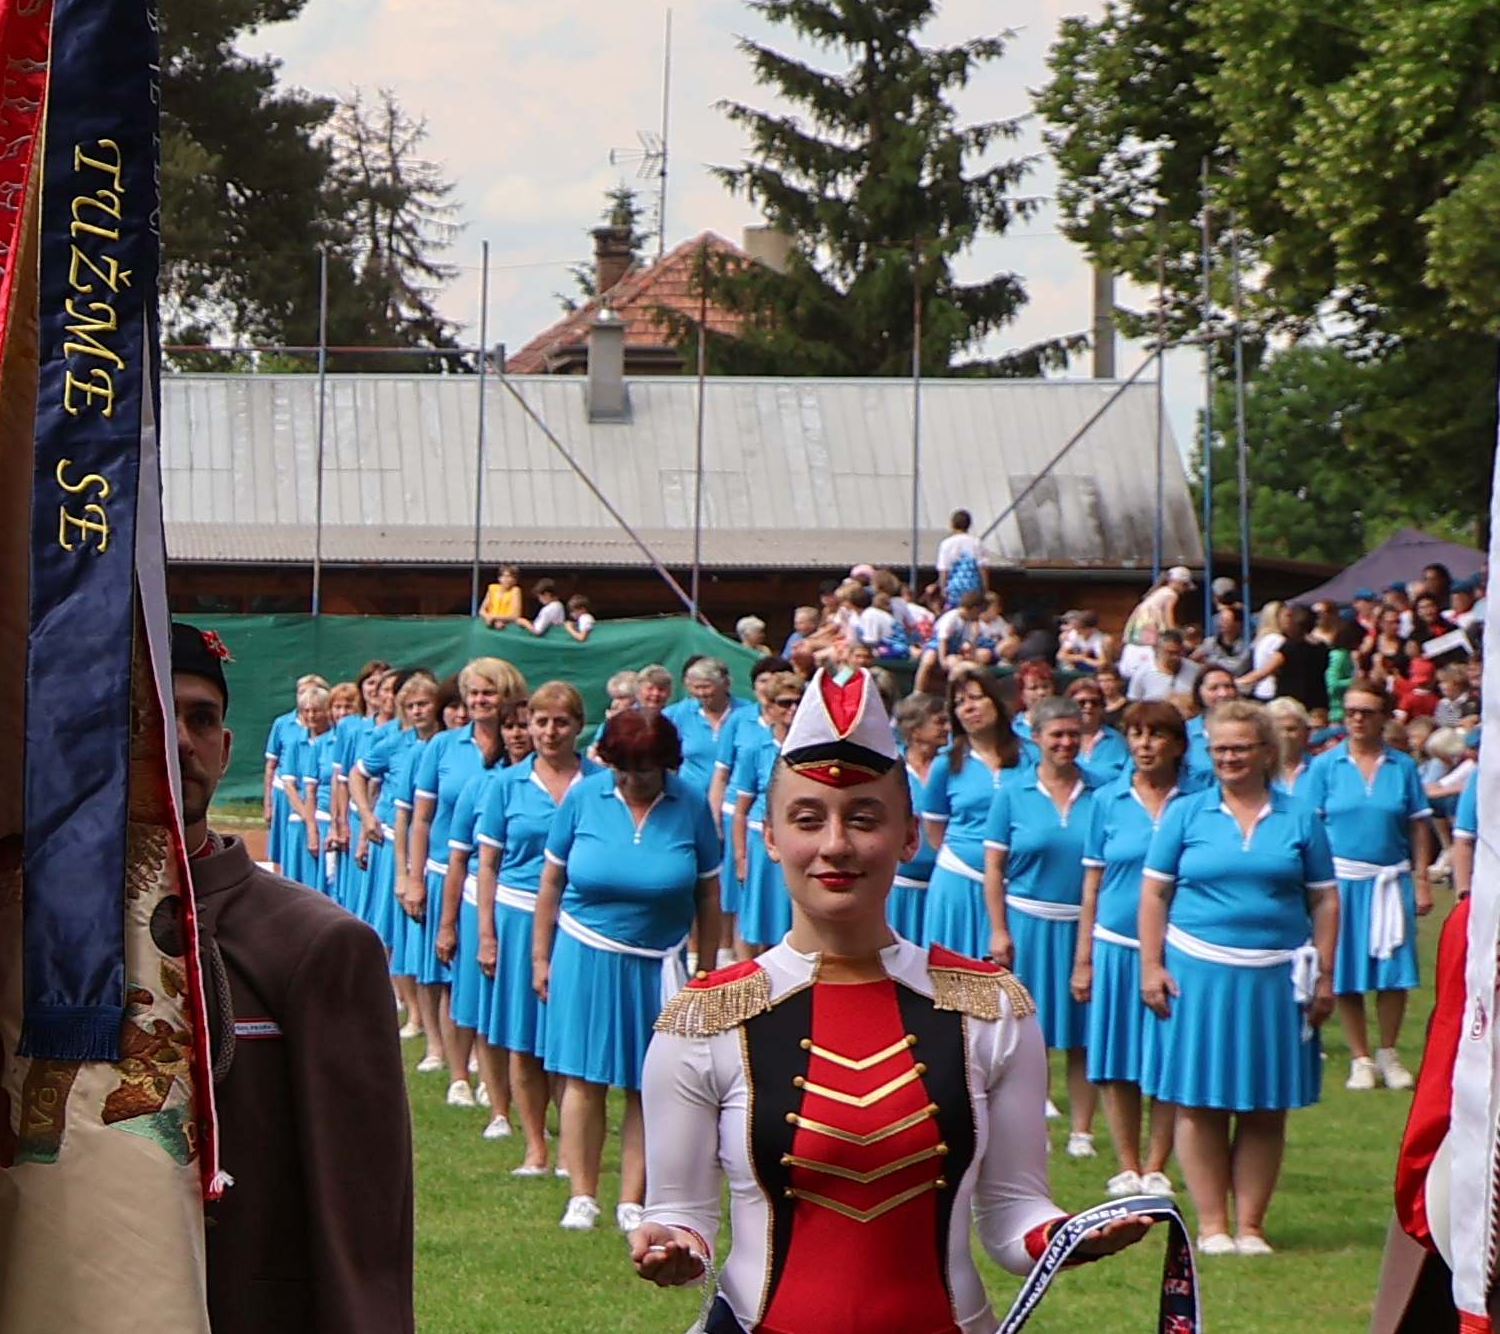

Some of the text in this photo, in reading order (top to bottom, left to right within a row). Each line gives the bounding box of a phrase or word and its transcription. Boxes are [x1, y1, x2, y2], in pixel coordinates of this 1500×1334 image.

[55, 139, 132, 551] TUŽME SE
[1045, 1232, 1067, 1270] NAD
